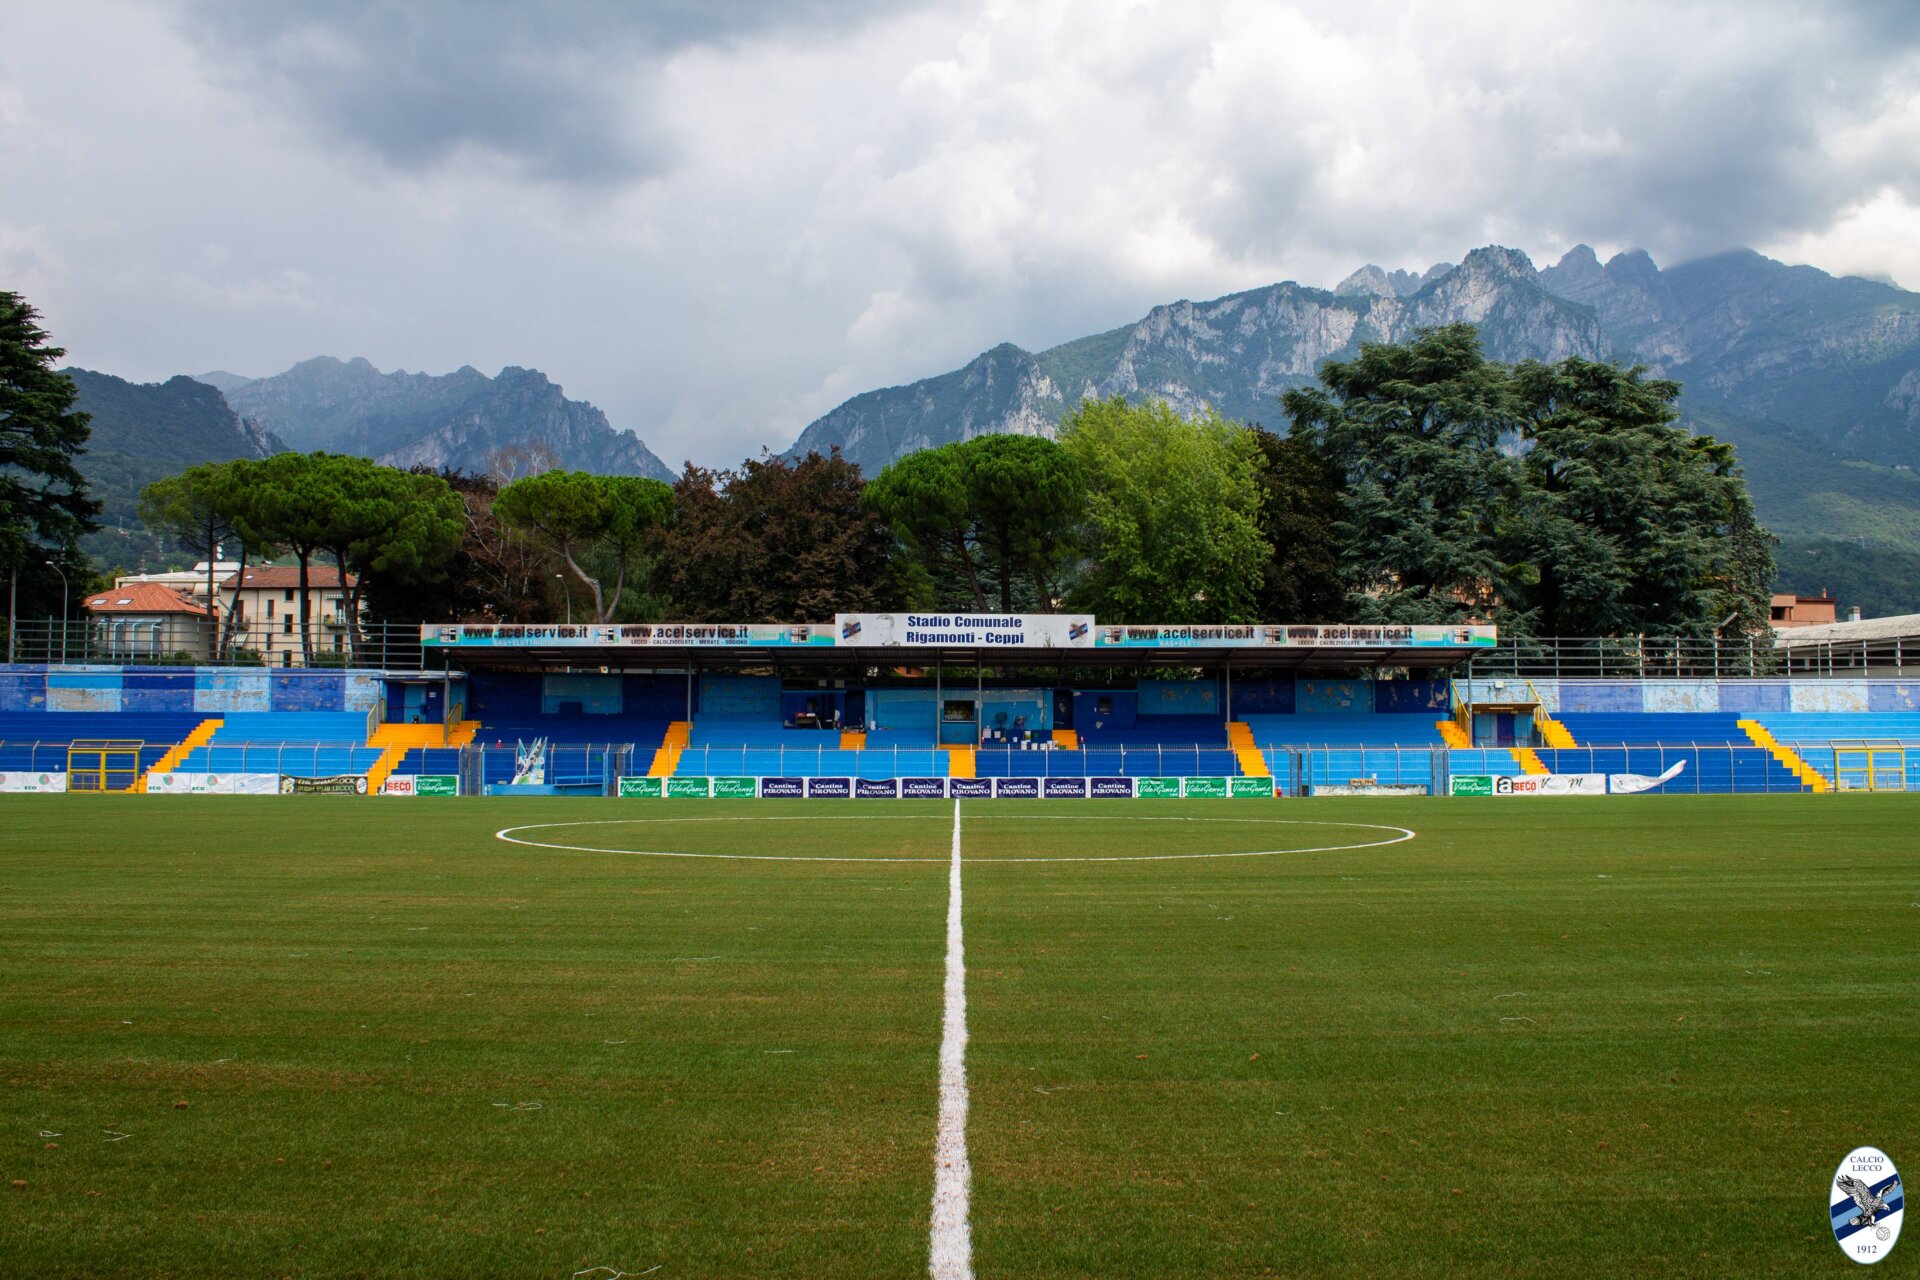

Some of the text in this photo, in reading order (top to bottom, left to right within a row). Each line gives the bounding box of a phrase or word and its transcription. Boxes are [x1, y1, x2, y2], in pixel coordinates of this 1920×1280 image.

[908, 615, 1022, 628] Stadio Comunale
[463, 625, 588, 638] www.acelservice.it
[620, 625, 748, 639] www.acelservice.it
[906, 631, 975, 644] Rigamonti
[985, 632, 1024, 644] Ceppi
[1127, 626, 1255, 639] www.acelservice.it
[1287, 626, 1413, 639] www.acelservice.it
[1186, 783, 1225, 795] VideoGames
[1232, 783, 1271, 795] VideoGames
